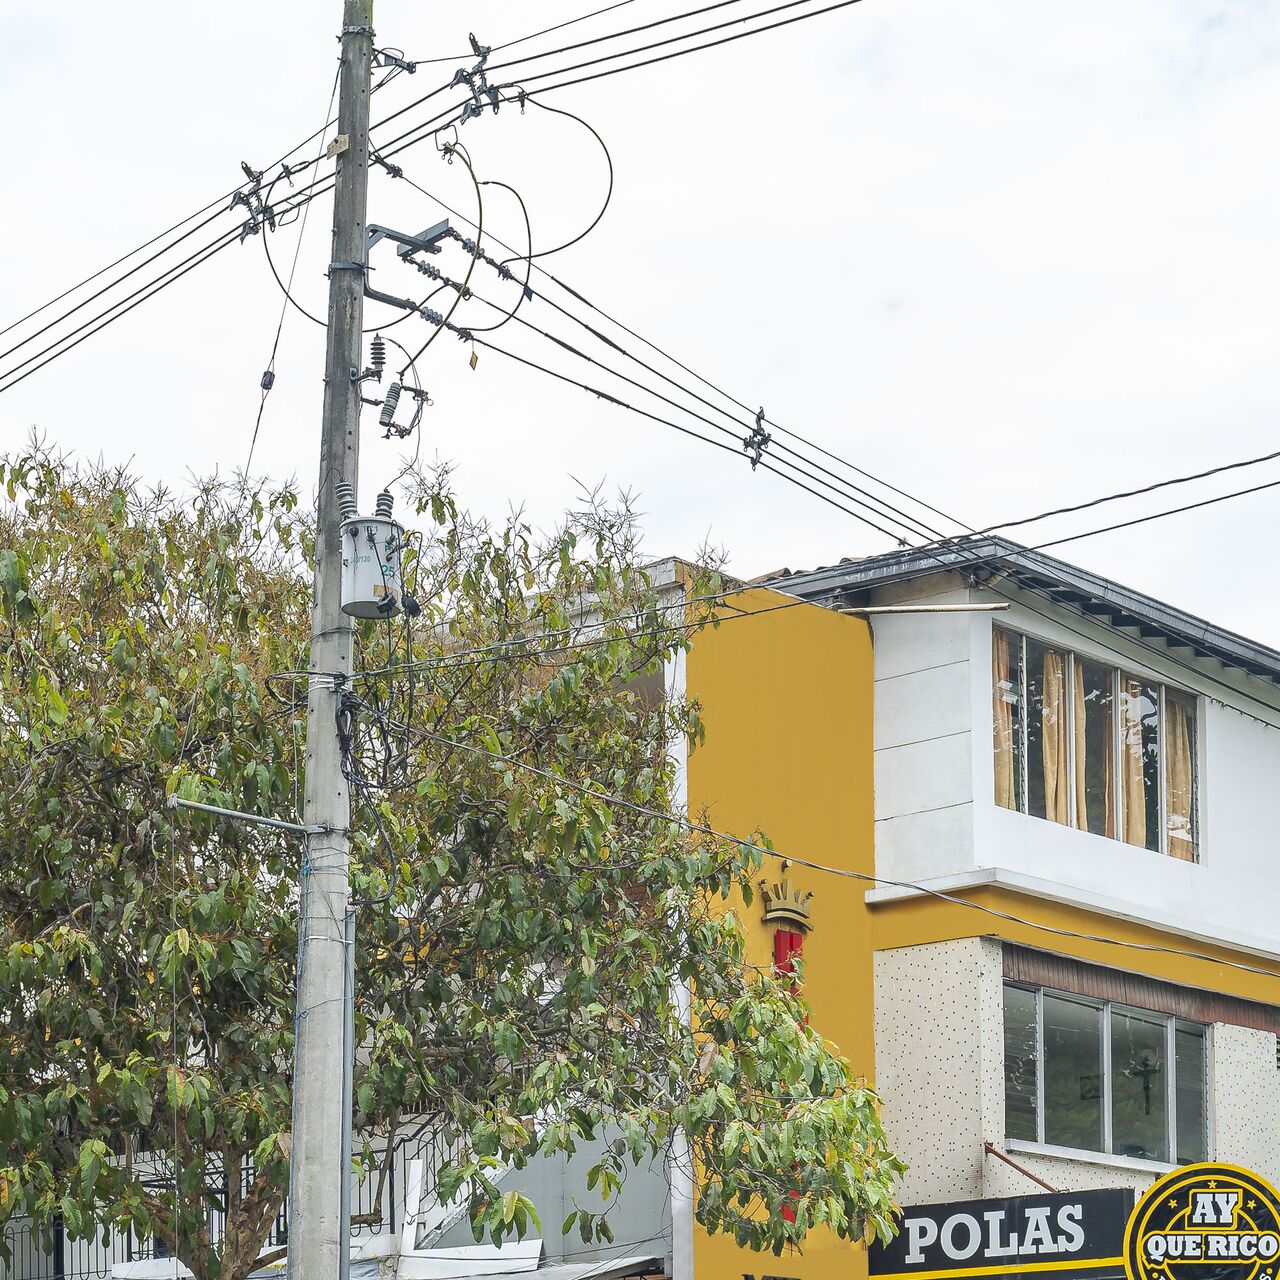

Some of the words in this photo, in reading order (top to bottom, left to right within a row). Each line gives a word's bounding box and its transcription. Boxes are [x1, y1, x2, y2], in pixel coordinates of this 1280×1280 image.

[1192, 1193, 1238, 1224] AY
[904, 1203, 1085, 1265] POLAS
[1147, 1235, 1202, 1262] QUE
[1207, 1235, 1278, 1257] RICO
